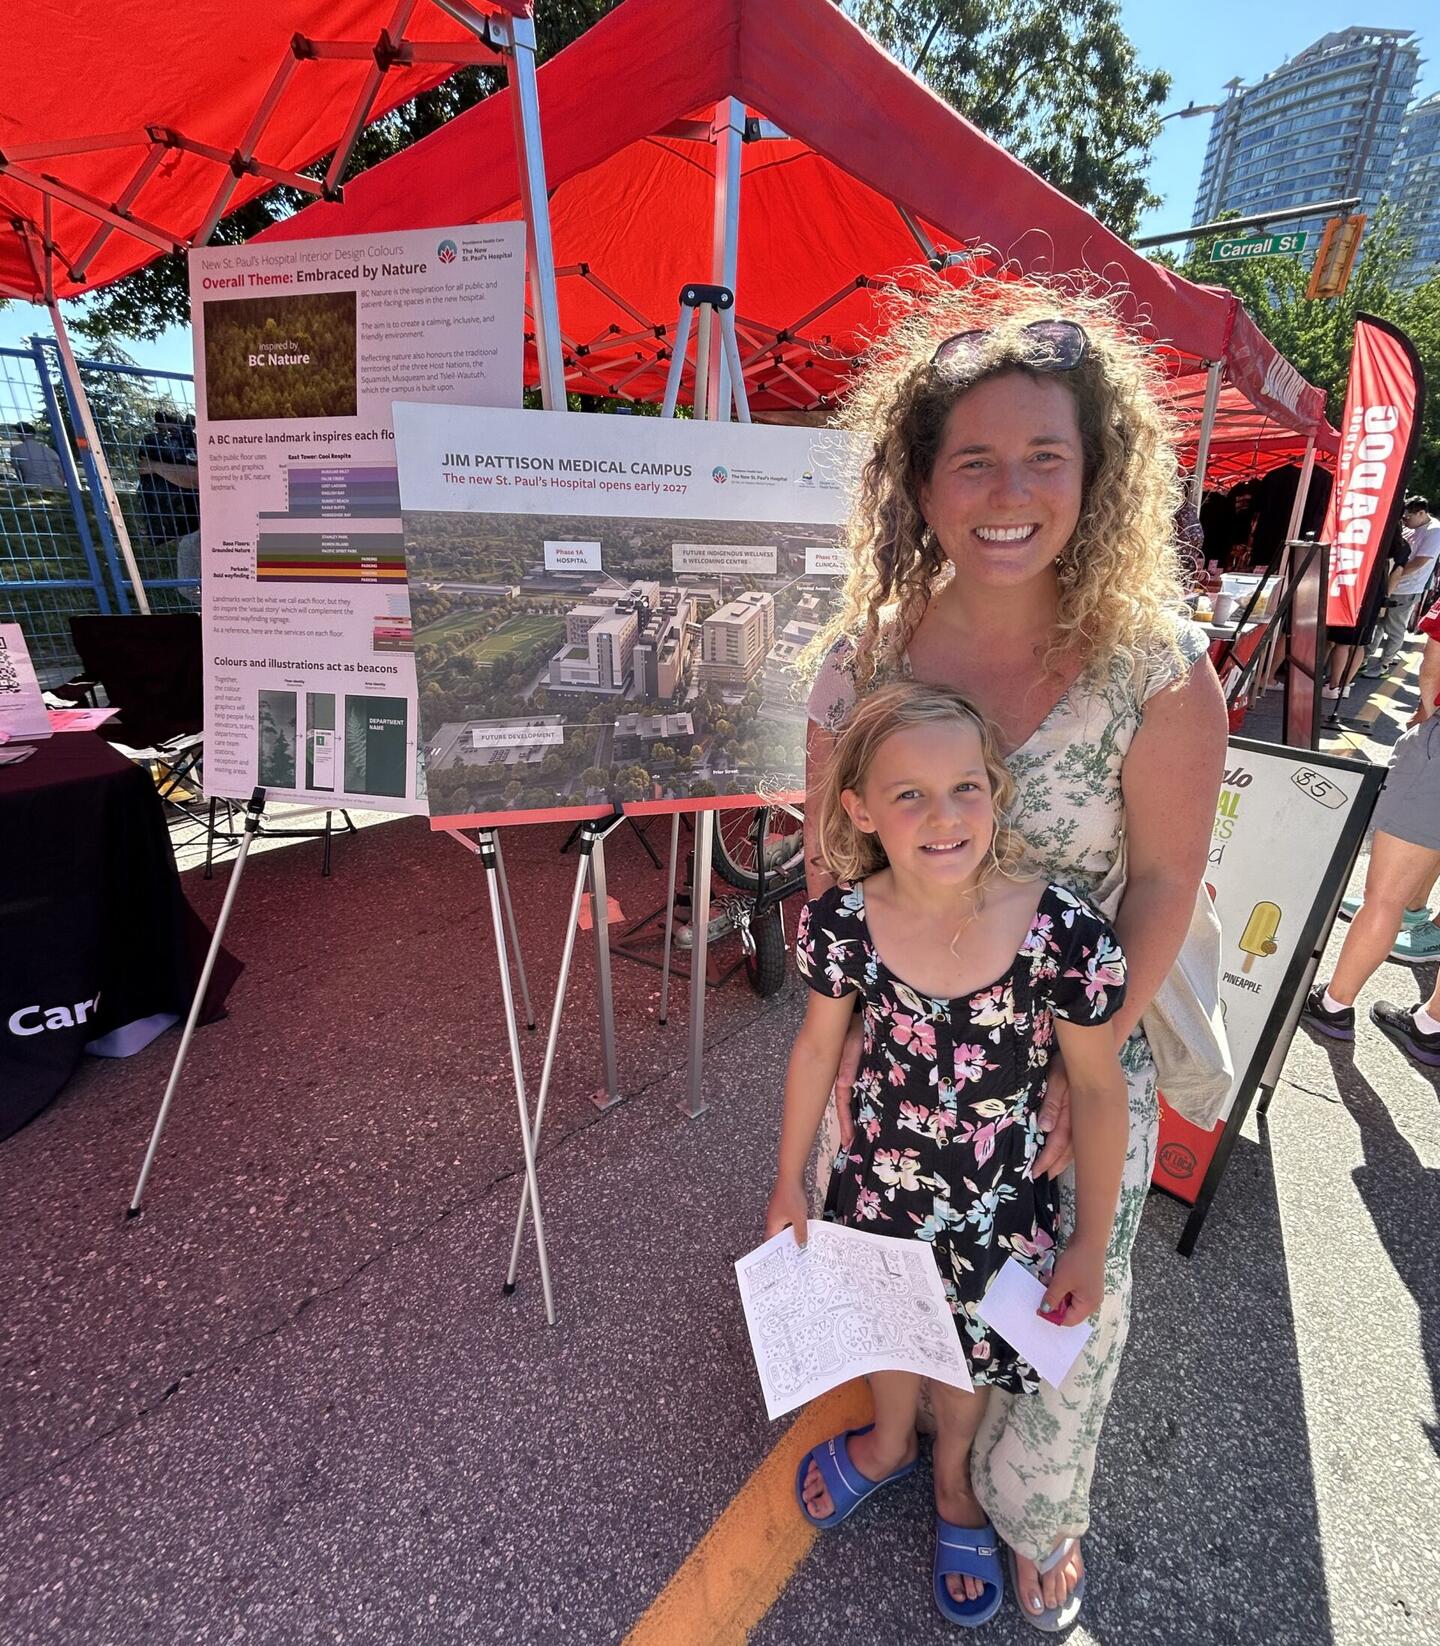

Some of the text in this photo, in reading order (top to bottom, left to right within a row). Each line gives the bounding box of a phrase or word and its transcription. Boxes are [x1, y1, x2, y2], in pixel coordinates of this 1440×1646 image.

[488, 252, 512, 261] Hospital
[1220, 236, 1298, 257] Carrall St
[202, 245, 403, 270] New St. Paul's Hospital Interior Design Colours
[202, 262, 427, 289] Overall Theme: Embraced by Nature
[259, 340, 298, 352] inspired by
[249, 353, 310, 366] BC Nature
[209, 435, 215, 444] A
[217, 434, 229, 444] BC
[232, 433, 262, 444] nature
[265, 432, 310, 443] landmark
[313, 431, 351, 444] inspires
[354, 430, 378, 440] each
[442, 454, 692, 476] JIM PATTISON MEDICAL CAMPUS
[443, 473, 465, 483] The
[495, 475, 512, 485] St.
[514, 476, 548, 486] Paul's
[550, 477, 595, 490] Hospital
[598, 481, 631, 492] opens
[634, 480, 659, 493] early
[663, 483, 687, 494] 2027
[214, 657, 247, 667] Colours
[249, 658, 266, 668] and
[268, 659, 324, 670] illustrations
[326, 661, 341, 671] act
[357, 663, 398, 673] beacons
[1296, 772, 1332, 798] $5
[1222, 972, 1262, 994] PINEAPPLE
[8, 991, 100, 1036] Car
